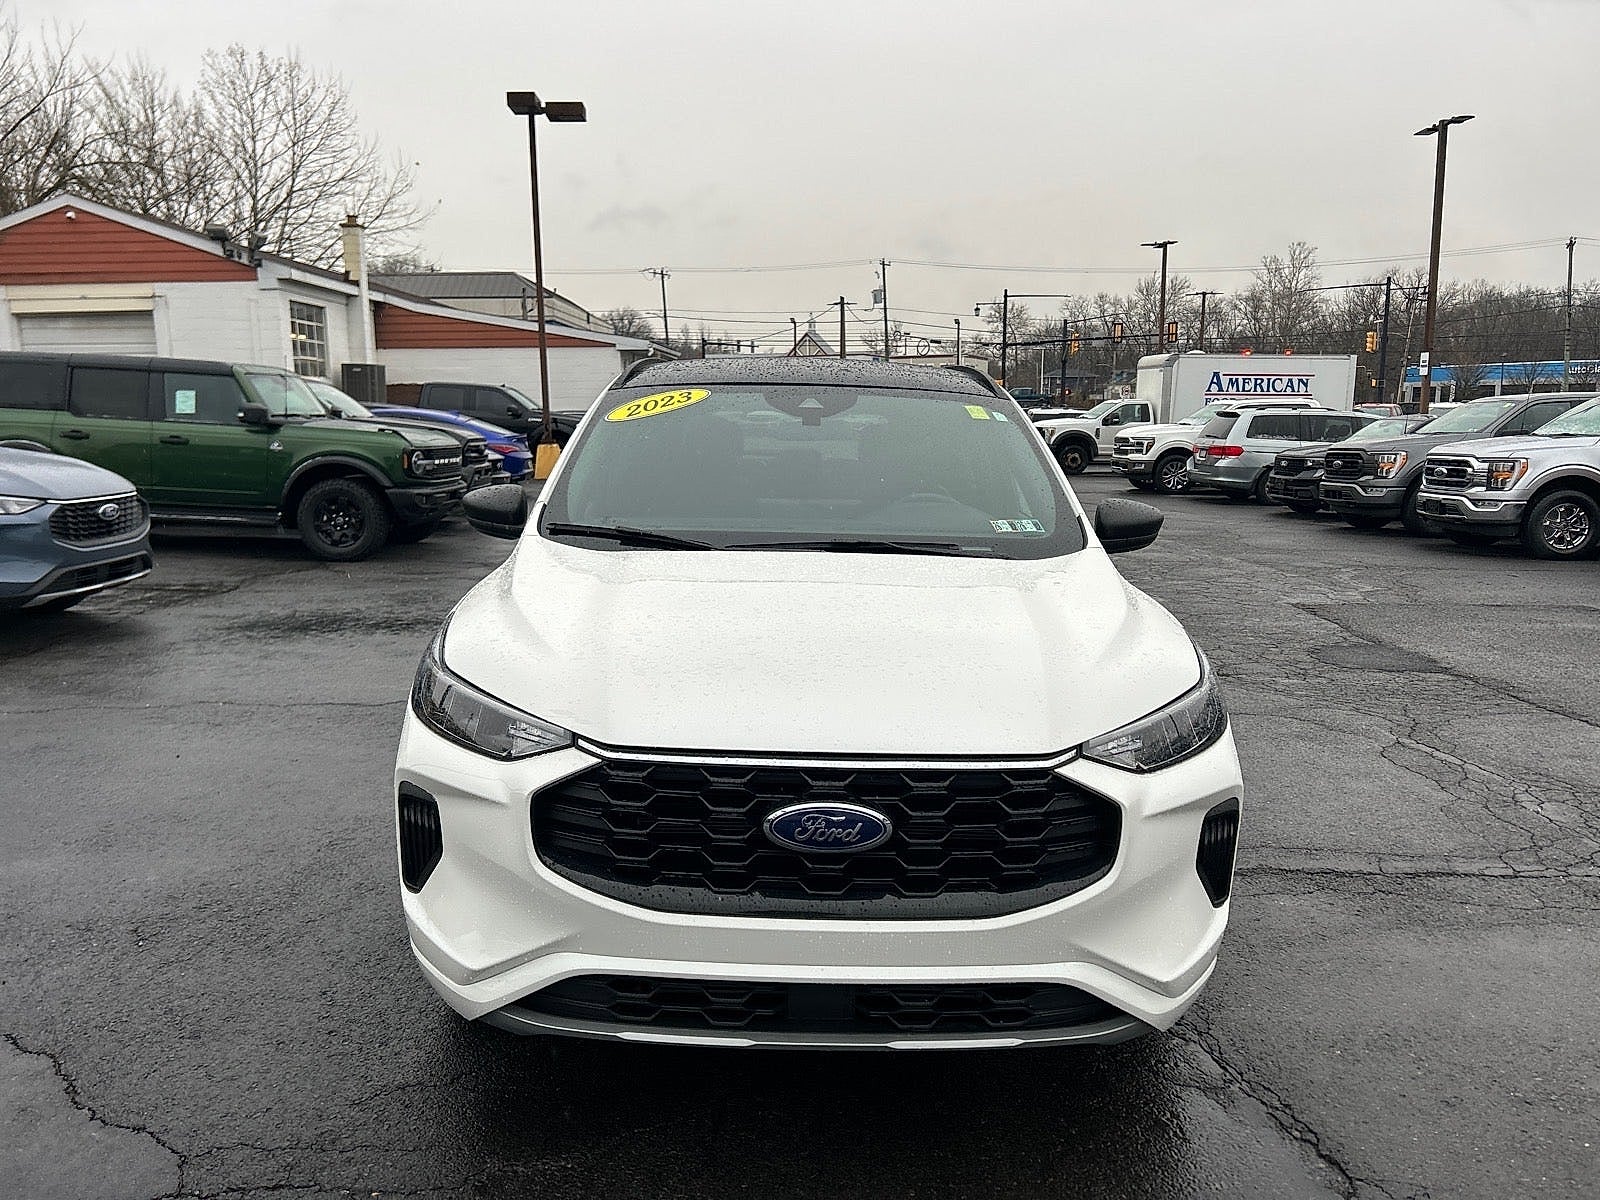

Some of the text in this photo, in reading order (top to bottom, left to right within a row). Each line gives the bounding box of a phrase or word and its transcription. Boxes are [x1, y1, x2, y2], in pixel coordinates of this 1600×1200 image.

[1205, 371, 1310, 393] AMERICAN
[626, 391, 692, 417] 2023
[794, 813, 863, 841] Ford
